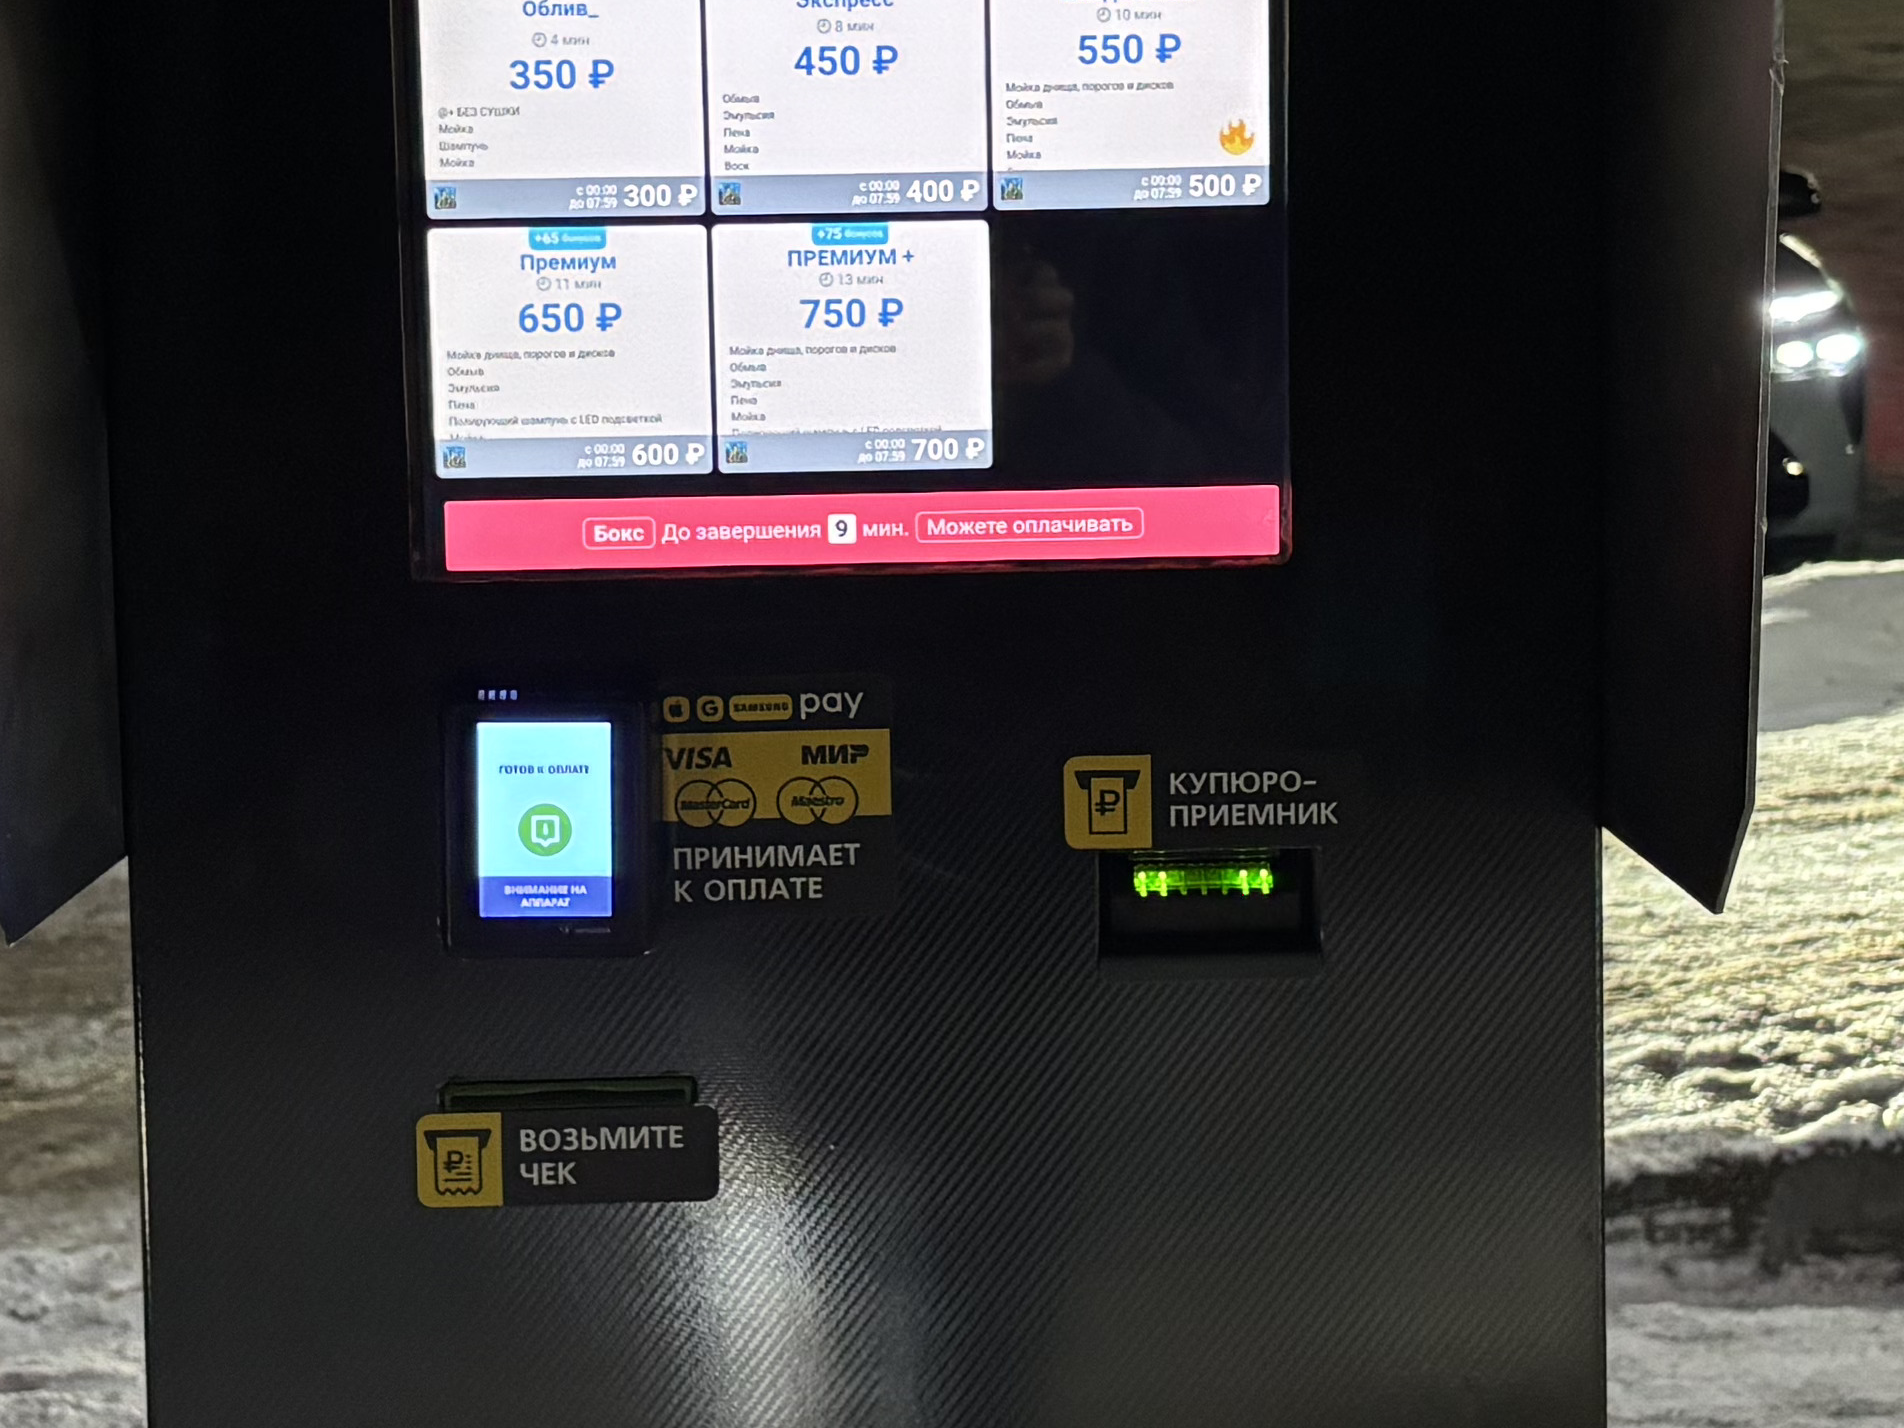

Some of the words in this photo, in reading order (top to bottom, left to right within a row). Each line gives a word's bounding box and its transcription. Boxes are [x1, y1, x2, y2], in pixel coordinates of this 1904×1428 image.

[522, 0, 599, 18] Облив_
[1115, 9, 1131, 20] 10
[835, 21, 843, 32] 8
[550, 34, 559, 45] 4
[1078, 34, 1143, 65] 550
[1155, 33, 1182, 63] ₽
[794, 45, 860, 76] 450
[872, 45, 898, 75] ₽
[509, 59, 577, 90] 350
[588, 59, 615, 89] ₽
[438, 123, 474, 134] Мойка
[724, 143, 759, 154] Мойка
[439, 157, 475, 169] Мойка
[724, 160, 749, 171] Воск
[868, 180, 900, 192] 00:00
[1150, 174, 1182, 186] 00:00
[1189, 174, 1235, 198] 500
[1242, 173, 1262, 196] ₽
[586, 185, 618, 197] 00:00
[623, 185, 671, 208] 300
[678, 184, 698, 207] ₽
[869, 193, 900, 205] 07:59
[906, 179, 954, 203] 400
[960, 180, 980, 202] ₽
[586, 197, 618, 210] 07:59
[520, 254, 617, 274] Премиум
[787, 248, 897, 267] ПРЕМИУМ
[902, 250, 915, 263] +
[555, 278, 570, 290] 11
[838, 273, 853, 286] 13
[518, 303, 584, 333] 650
[595, 302, 622, 332] ₽
[799, 298, 866, 329] 750
[878, 298, 904, 327] ₽
[579, 414, 599, 425] LED
[594, 443, 625, 455] 00:00
[632, 443, 678, 466] 600
[685, 442, 705, 465] ₽
[911, 438, 958, 461] 700
[965, 437, 985, 460] ₽
[594, 456, 625, 468] 07:59
[593, 524, 645, 543] Бокс
[661, 524, 691, 544] До
[695, 522, 822, 542] завершения
[834, 519, 848, 538] 9
[862, 520, 910, 537] мин.
[926, 517, 1008, 536] Можете
[1013, 515, 1134, 535] оплачивать
[733, 702, 790, 713] SAMSUNG
[799, 691, 863, 721] pay
[664, 746, 732, 770] VISA
[801, 744, 869, 765] МИР
[499, 764, 534, 775] ГОТОВ
[1169, 770, 1317, 795] КУПЮРО-
[680, 798, 750, 811] MasterCard
[792, 795, 844, 807] Maestro
[1170, 802, 1338, 827] ПРИЕМНИК
[673, 843, 861, 871] ПРИНИМАЕТ
[571, 884, 587, 895] НА
[674, 880, 693, 902] К
[704, 876, 823, 901] ОПЛАТЕ
[520, 1125, 684, 1152] ВОЗЬМИТЕ
[520, 1161, 577, 1186] ЧЕК
